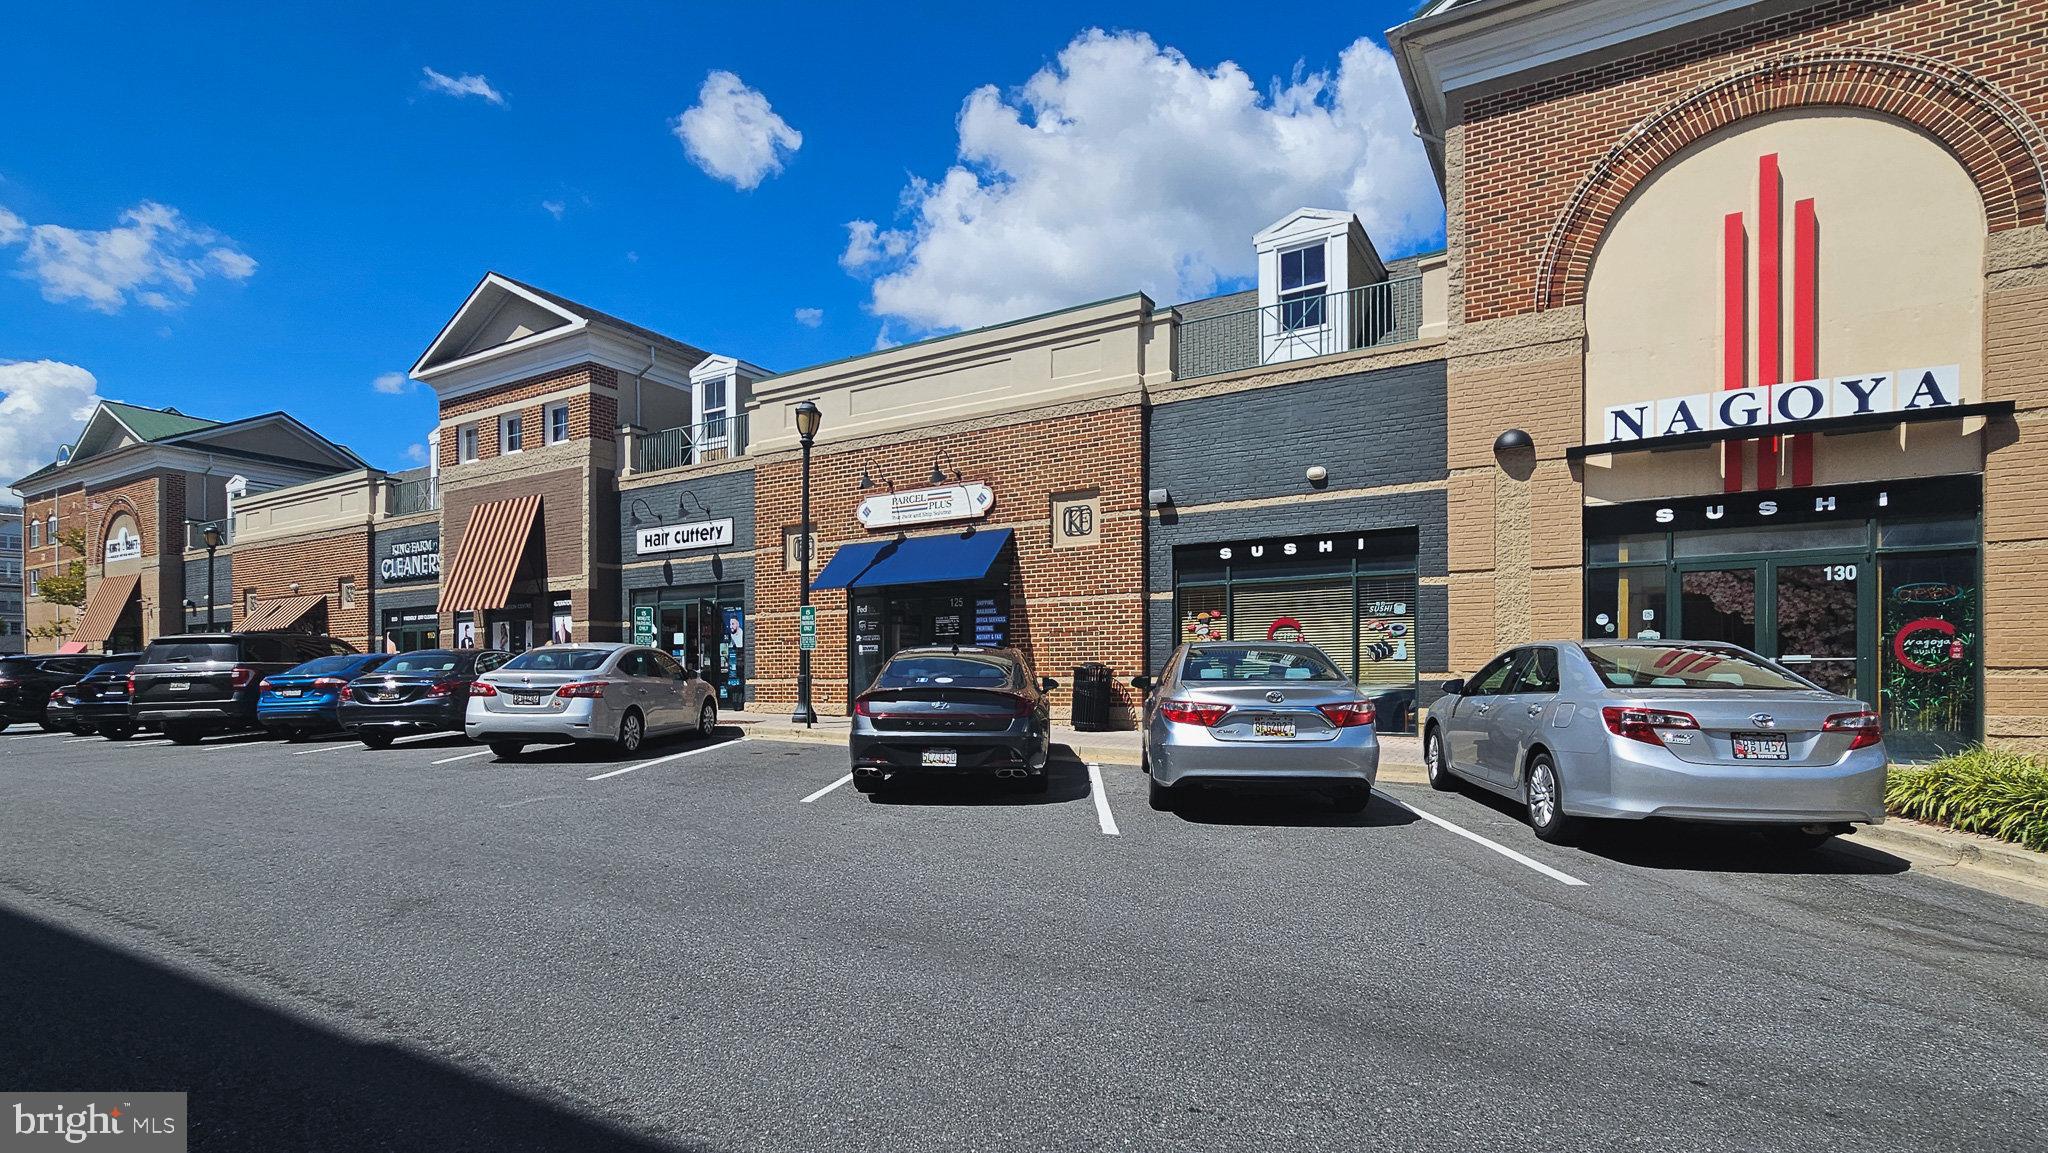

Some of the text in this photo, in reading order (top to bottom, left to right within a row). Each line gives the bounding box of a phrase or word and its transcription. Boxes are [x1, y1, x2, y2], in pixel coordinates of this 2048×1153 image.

[1610, 370, 1952, 441] NAGOYA
[892, 494, 927, 506] PARCEL
[929, 500, 952, 509] PLUS
[1655, 491, 1889, 523] SUSHI
[645, 532, 669, 547] Hair
[1220, 538, 1363, 559] SUSHI
[1823, 565, 1857, 581] 130
[950, 597, 964, 607] 125
[1368, 604, 1393, 613] SUSHI
[1903, 639, 1951, 649] Nagoya
